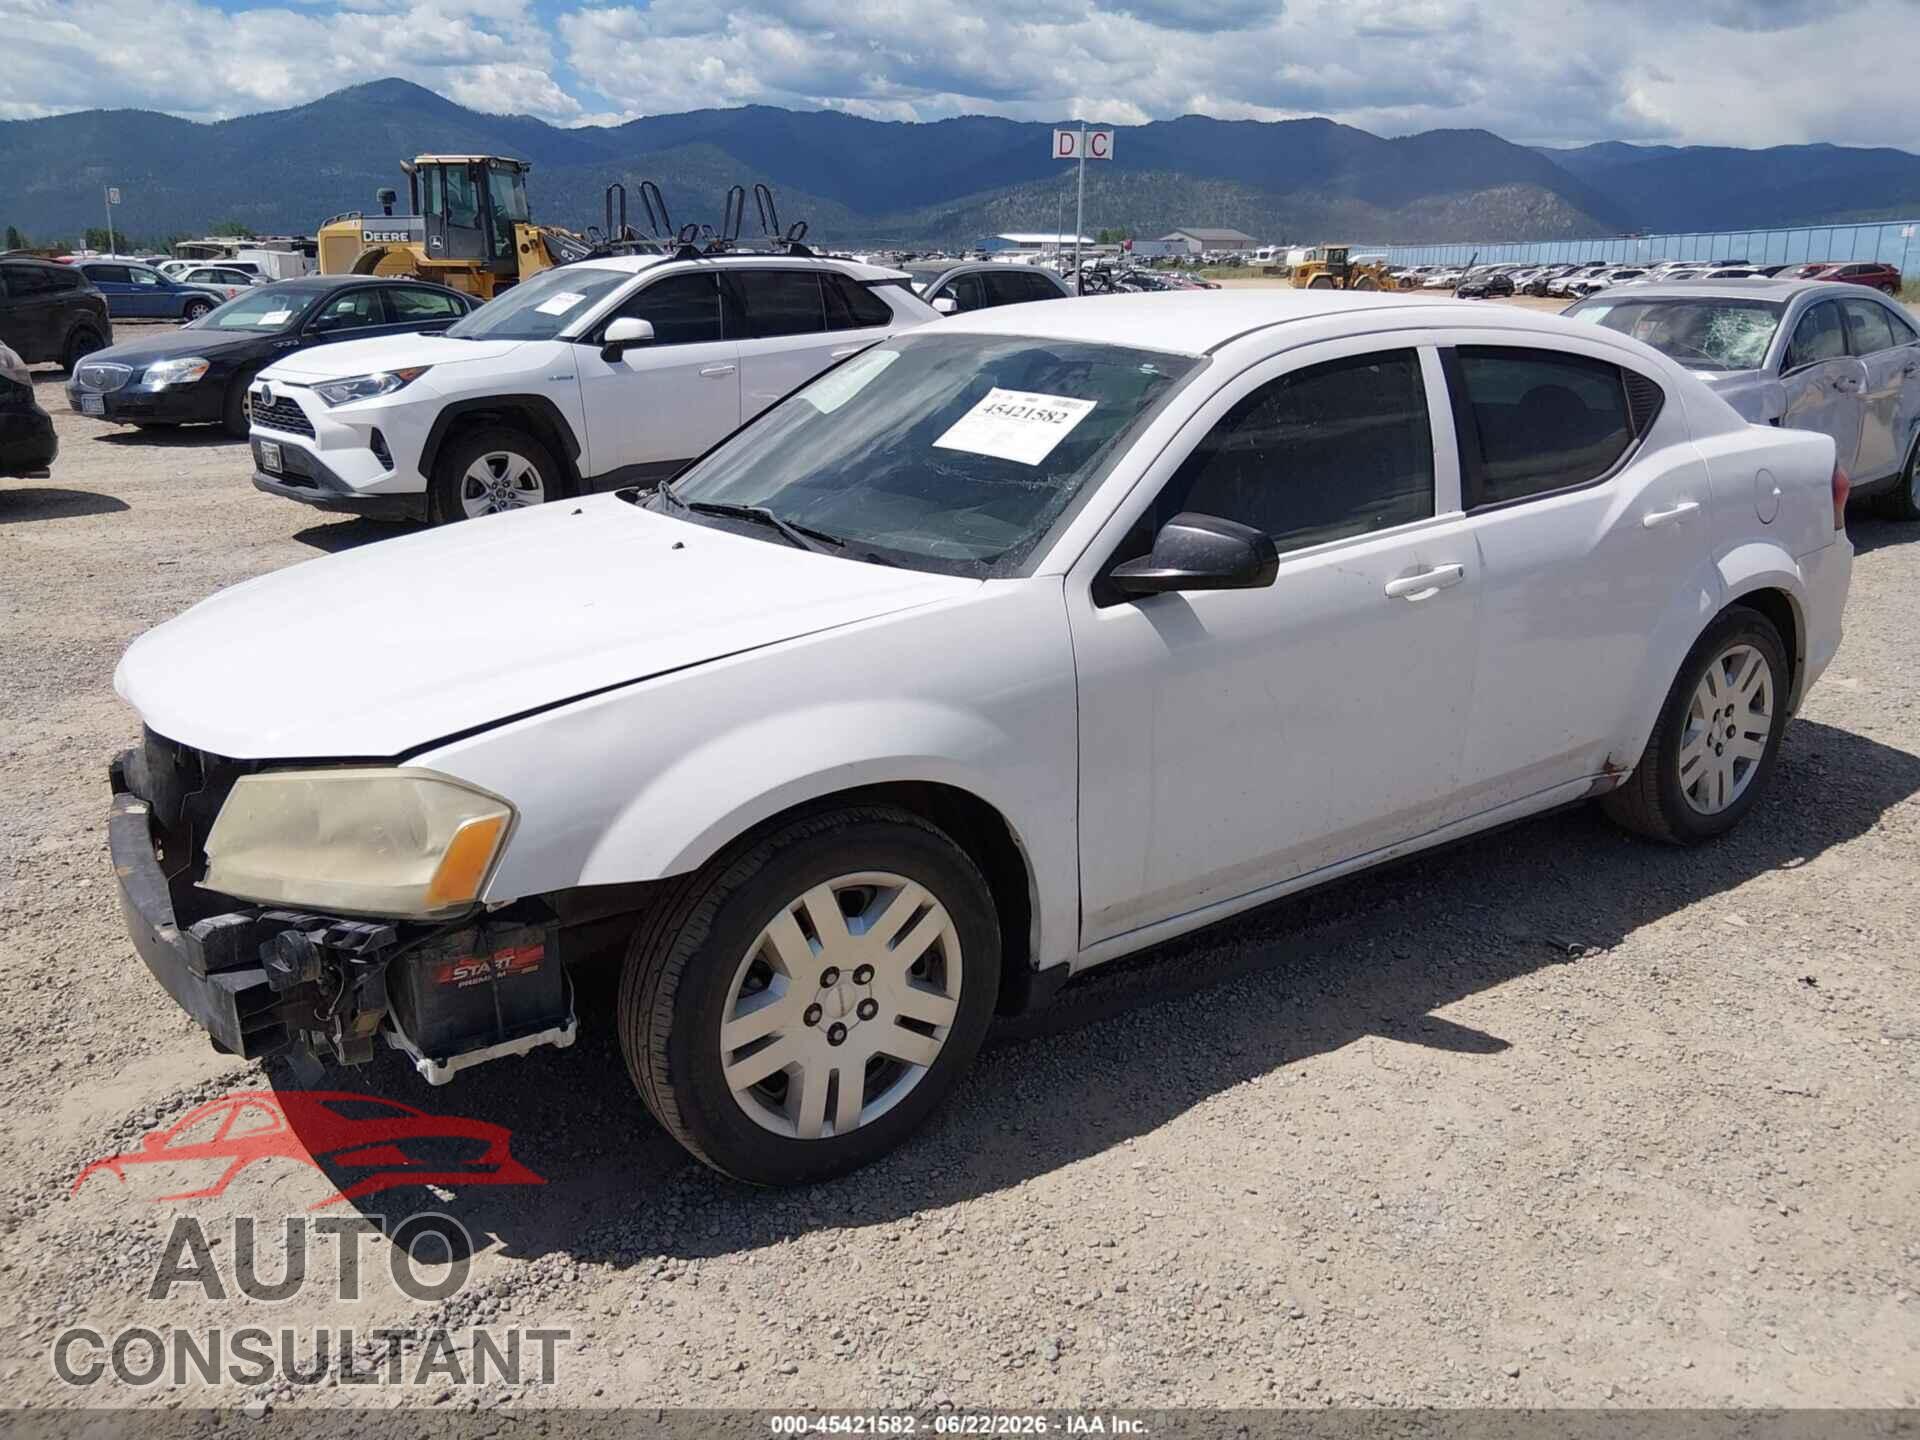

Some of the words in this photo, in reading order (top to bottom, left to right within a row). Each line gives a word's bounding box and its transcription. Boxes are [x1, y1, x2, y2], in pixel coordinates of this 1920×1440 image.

[1060, 132, 1075, 156] D
[1092, 132, 1108, 157] C
[363, 230, 409, 242] DEERE
[983, 403, 1069, 425] 45421582
